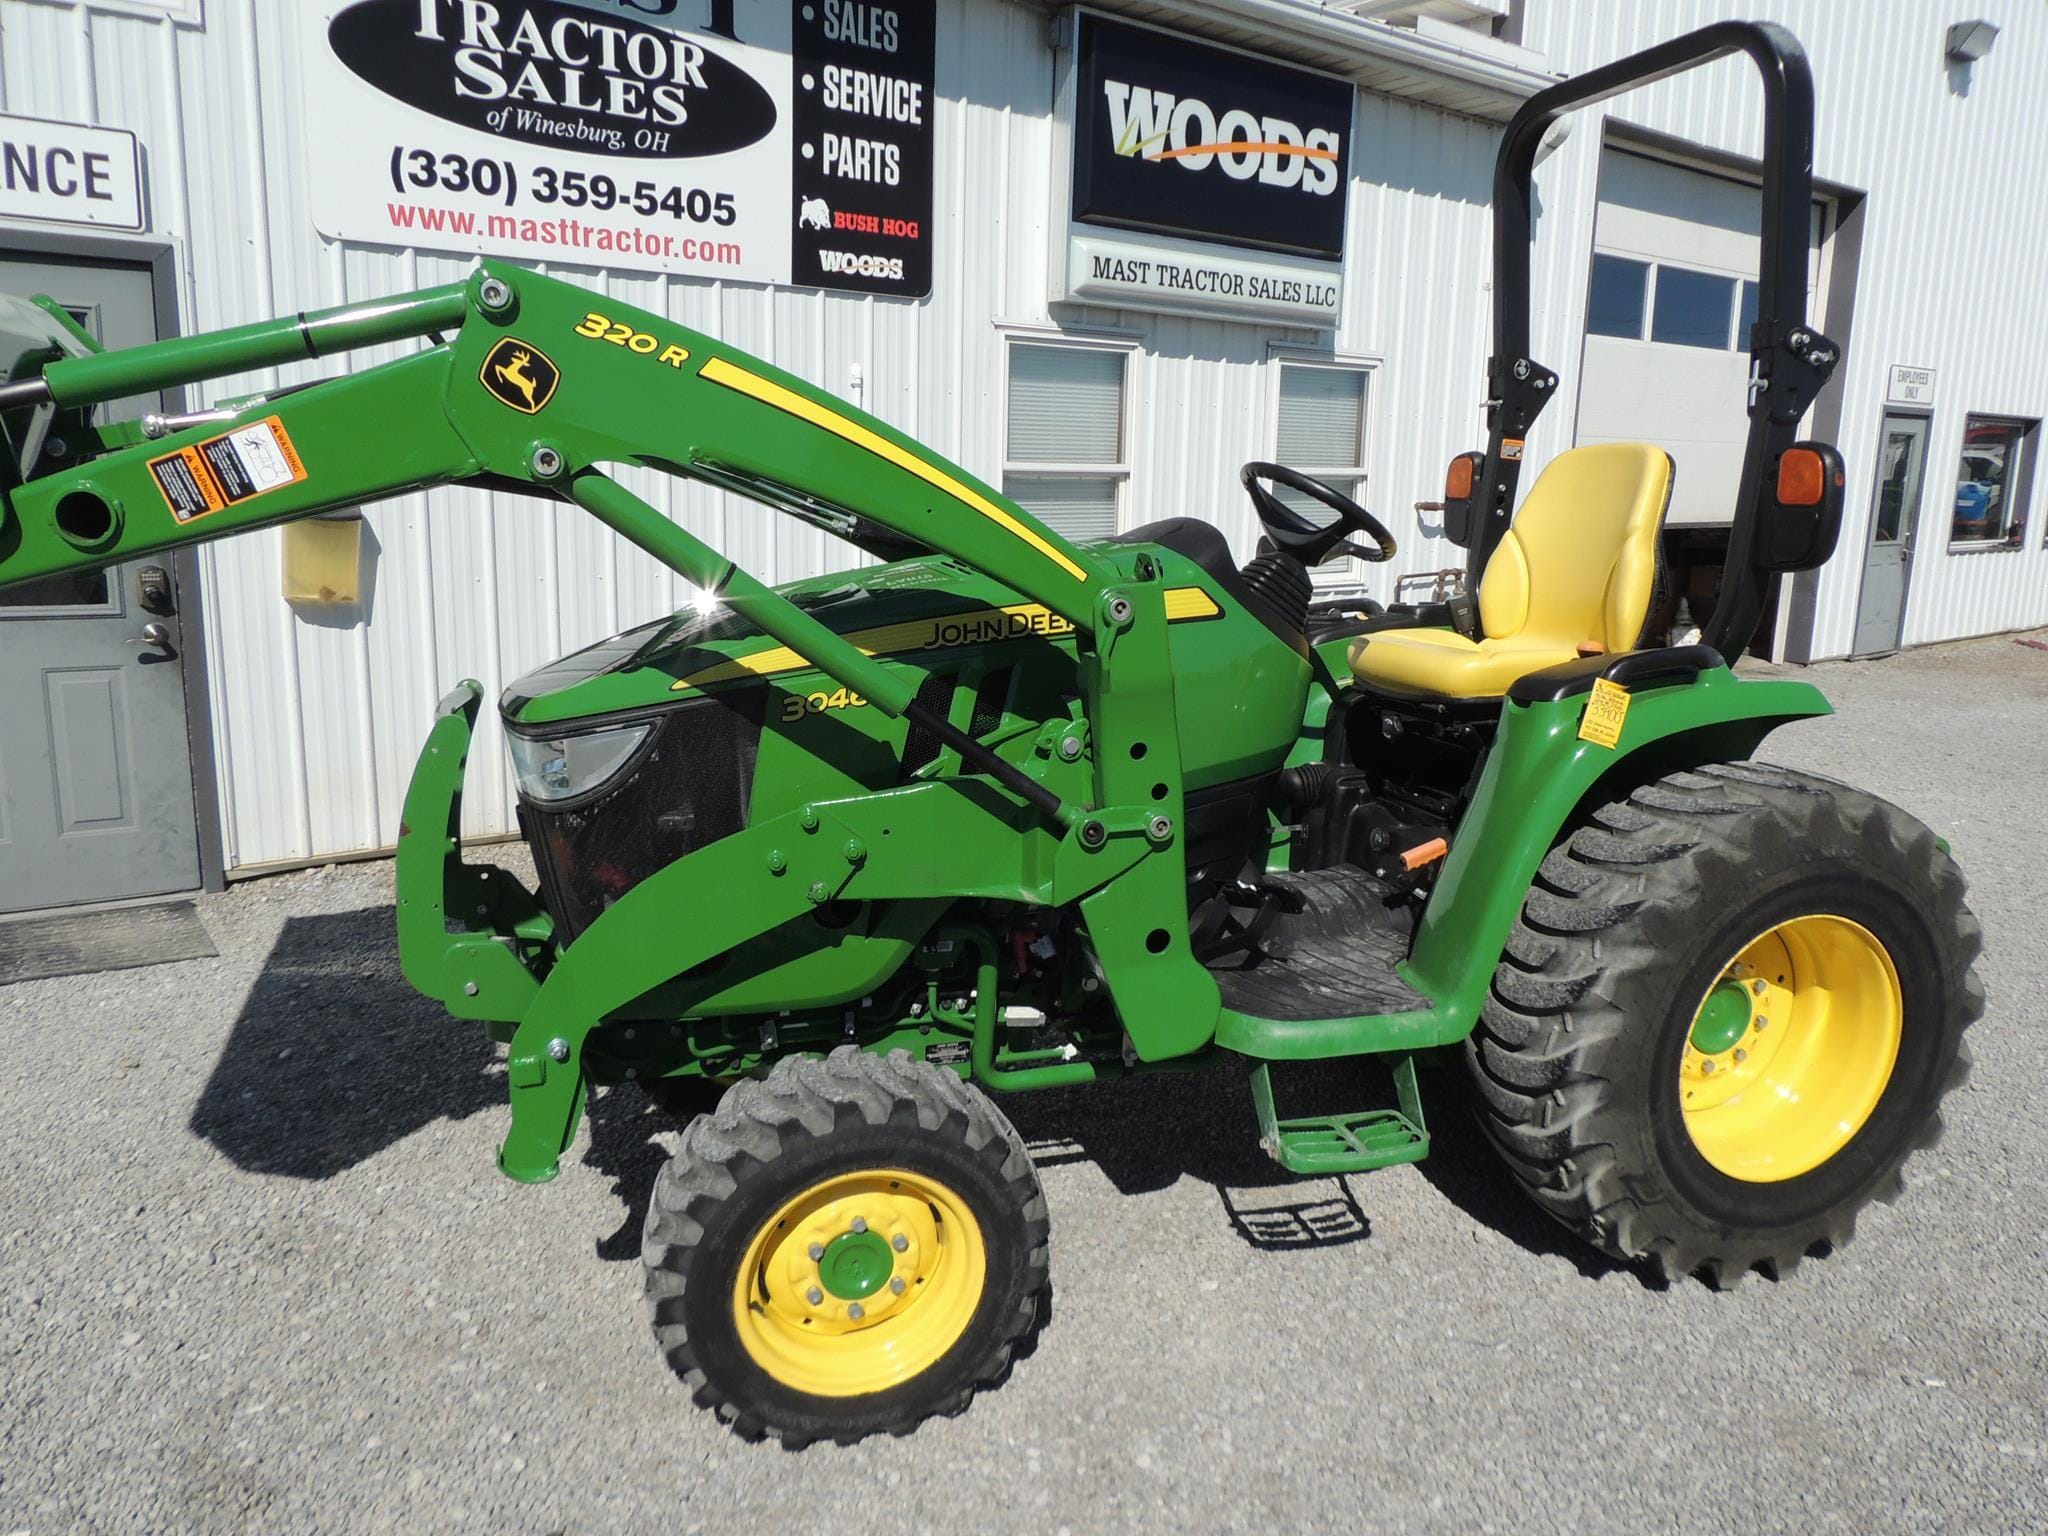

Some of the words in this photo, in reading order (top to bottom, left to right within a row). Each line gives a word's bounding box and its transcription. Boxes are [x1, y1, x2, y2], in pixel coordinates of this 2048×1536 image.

[414, 0, 708, 89] TRACTOR
[823, 0, 899, 53] SALES
[454, 47, 688, 126] SALES
[822, 64, 922, 125] SERVICE
[486, 106, 513, 132] of
[516, 109, 626, 150] Winesburg,
[633, 128, 671, 152] OH
[1104, 79, 1340, 196] WOODS
[0, 141, 113, 201] NCE
[822, 132, 900, 186] PARTS
[390, 145, 518, 207] (330)
[531, 166, 737, 227] 359-5405
[387, 203, 742, 265] www.masttractor.com
[834, 211, 877, 234] BUSH
[882, 217, 919, 239] HOG
[819, 249, 904, 280] WOODS
[1092, 255, 1150, 284] MAST
[1156, 264, 1244, 297] TRACTOR
[1249, 276, 1302, 303] SALES
[1305, 284, 1336, 308] LLC
[573, 312, 660, 354] 320
[657, 343, 691, 369] R
[1897, 369, 1929, 385] EMPLOYEES
[1904, 385, 1919, 399] ONLY
[276, 433, 302, 474] WARNING
[191, 464, 217, 506] WARNING
[923, 618, 1002, 649] JOHN
